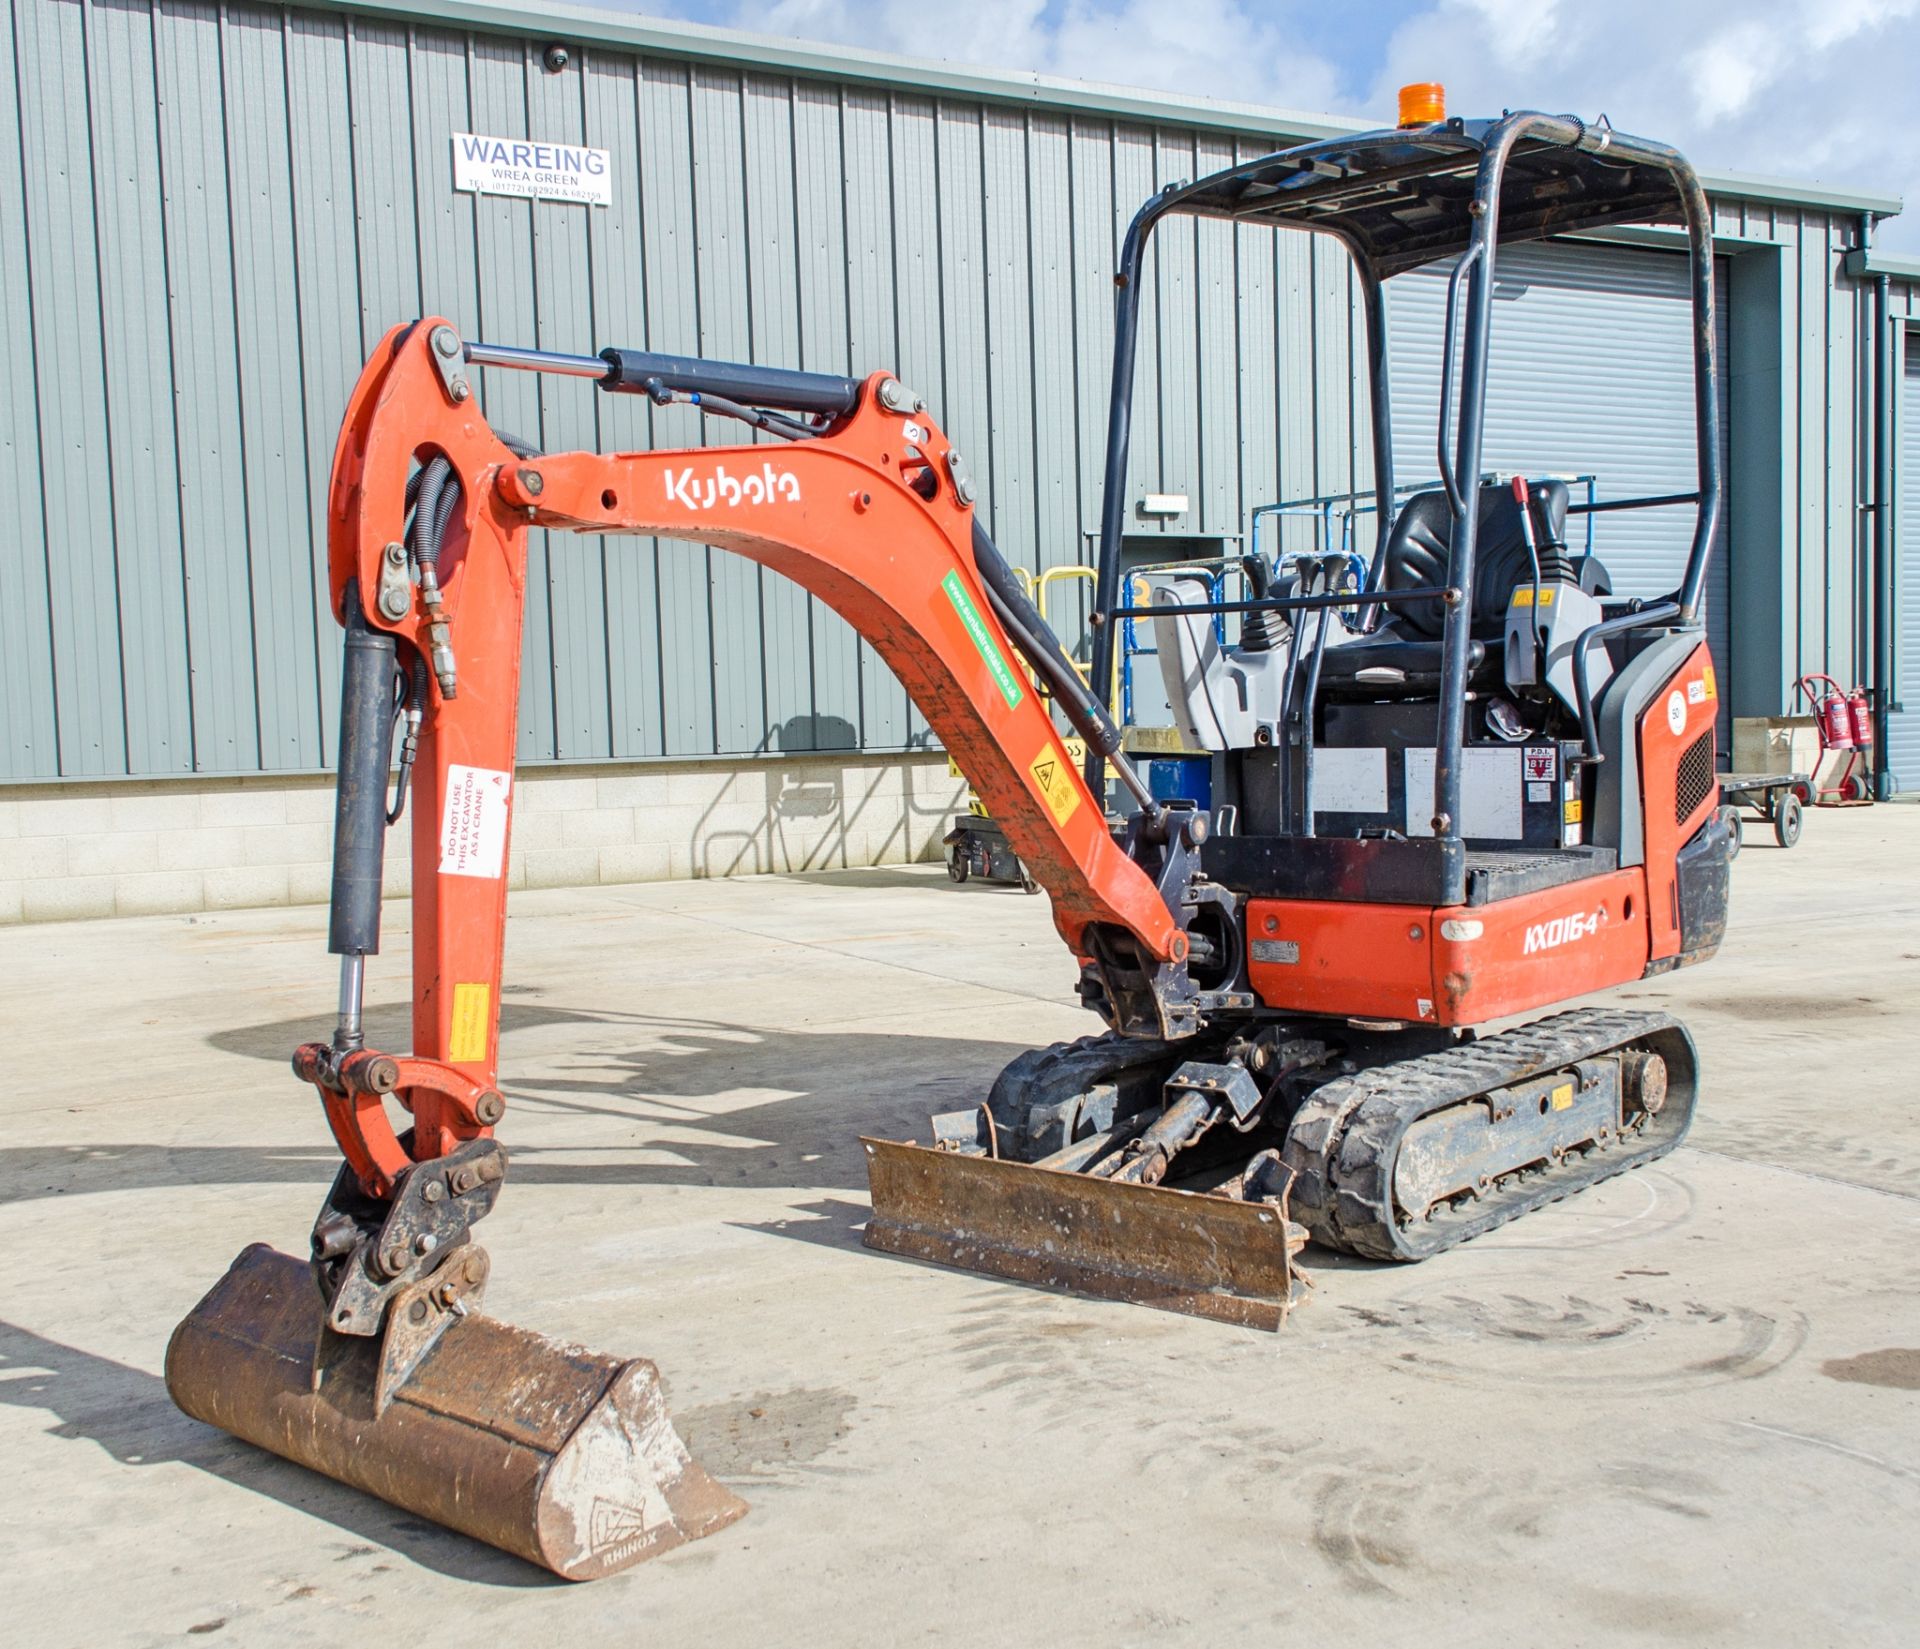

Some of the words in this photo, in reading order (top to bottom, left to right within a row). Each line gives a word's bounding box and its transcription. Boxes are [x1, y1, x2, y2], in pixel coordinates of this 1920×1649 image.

[462, 138, 604, 175] WAREING
[491, 168, 530, 182] WREA
[534, 172, 579, 186] GREEN
[562, 188, 569, 196] &
[664, 463, 800, 510] Kubota
[948, 578, 1017, 701] www.sunbeltrentals.co.uk
[1530, 759, 1552, 768] BTE
[453, 783, 462, 805] USE
[460, 771, 474, 841] EXCAVATOR
[473, 788, 484, 828] CRANE
[450, 809, 459, 835] NOT
[472, 831, 479, 839] A
[448, 838, 457, 856] DO
[457, 844, 467, 870] THIS
[470, 842, 478, 856] AS
[603, 1531, 658, 1567] RHINOX
